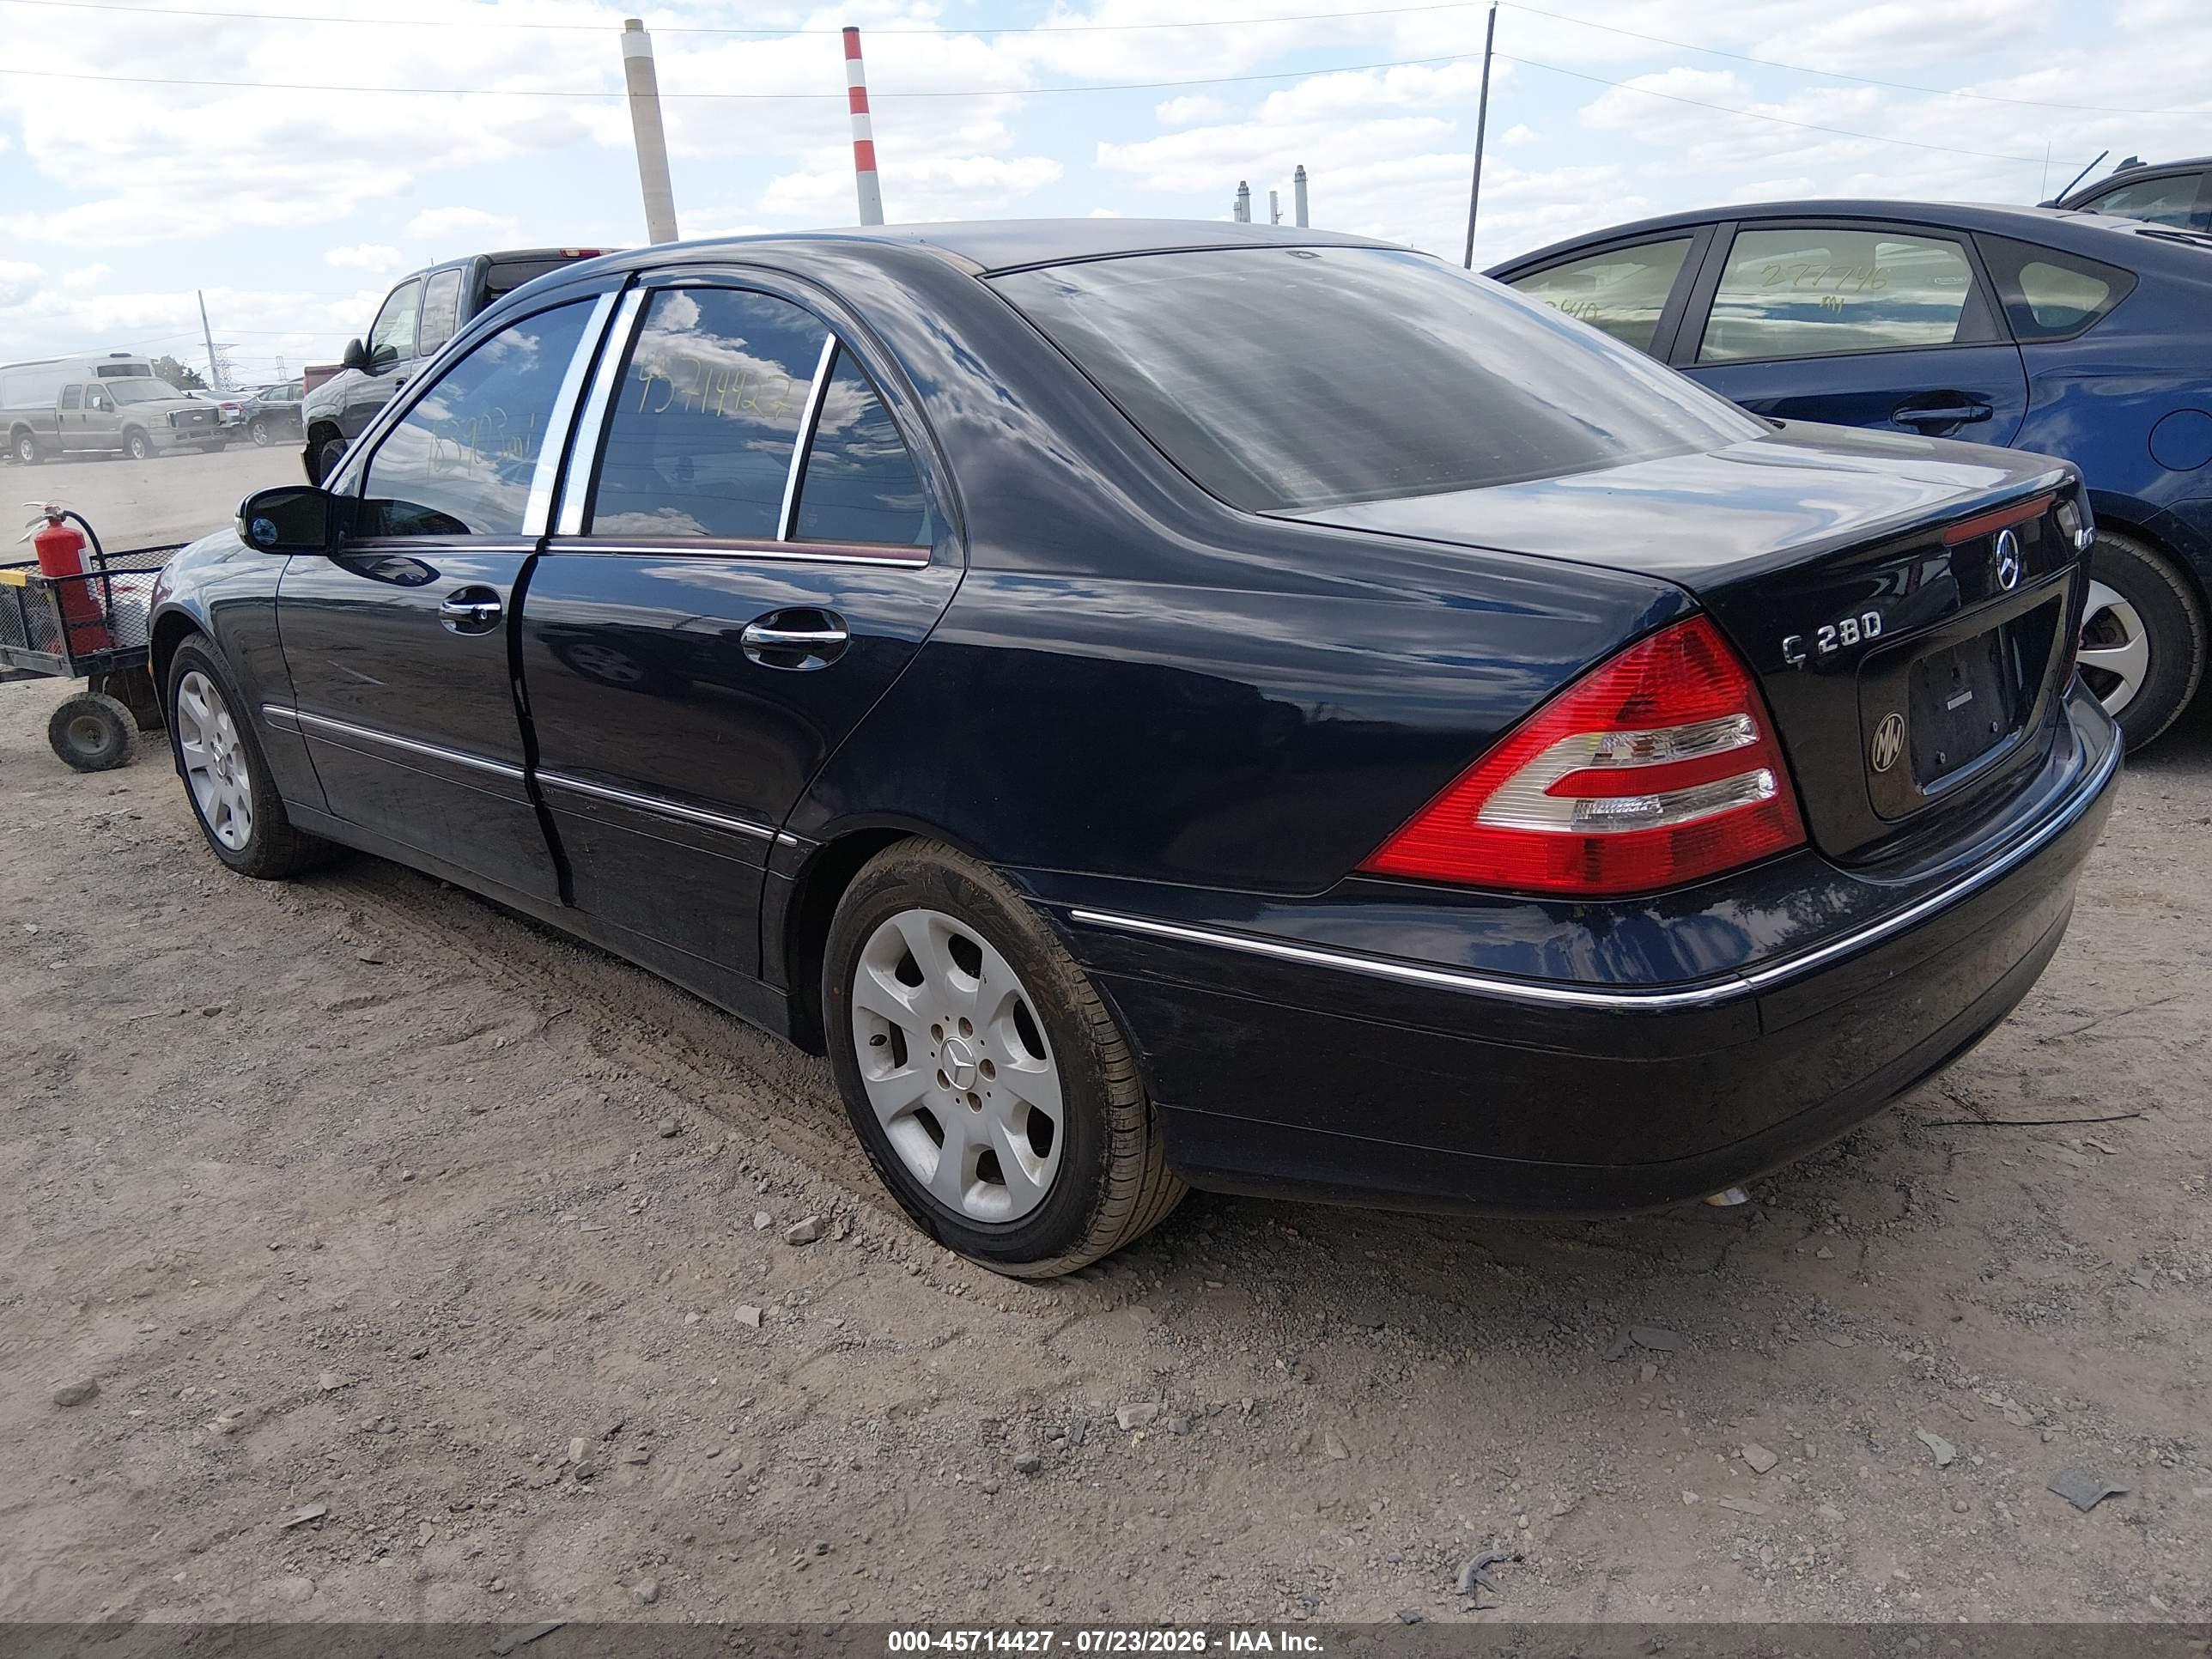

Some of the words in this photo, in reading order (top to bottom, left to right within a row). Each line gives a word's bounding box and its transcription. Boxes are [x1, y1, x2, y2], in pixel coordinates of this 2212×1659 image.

[638, 357, 794, 421] 45714427
[1783, 635, 1807, 665] C
[1817, 611, 1882, 655] 280
